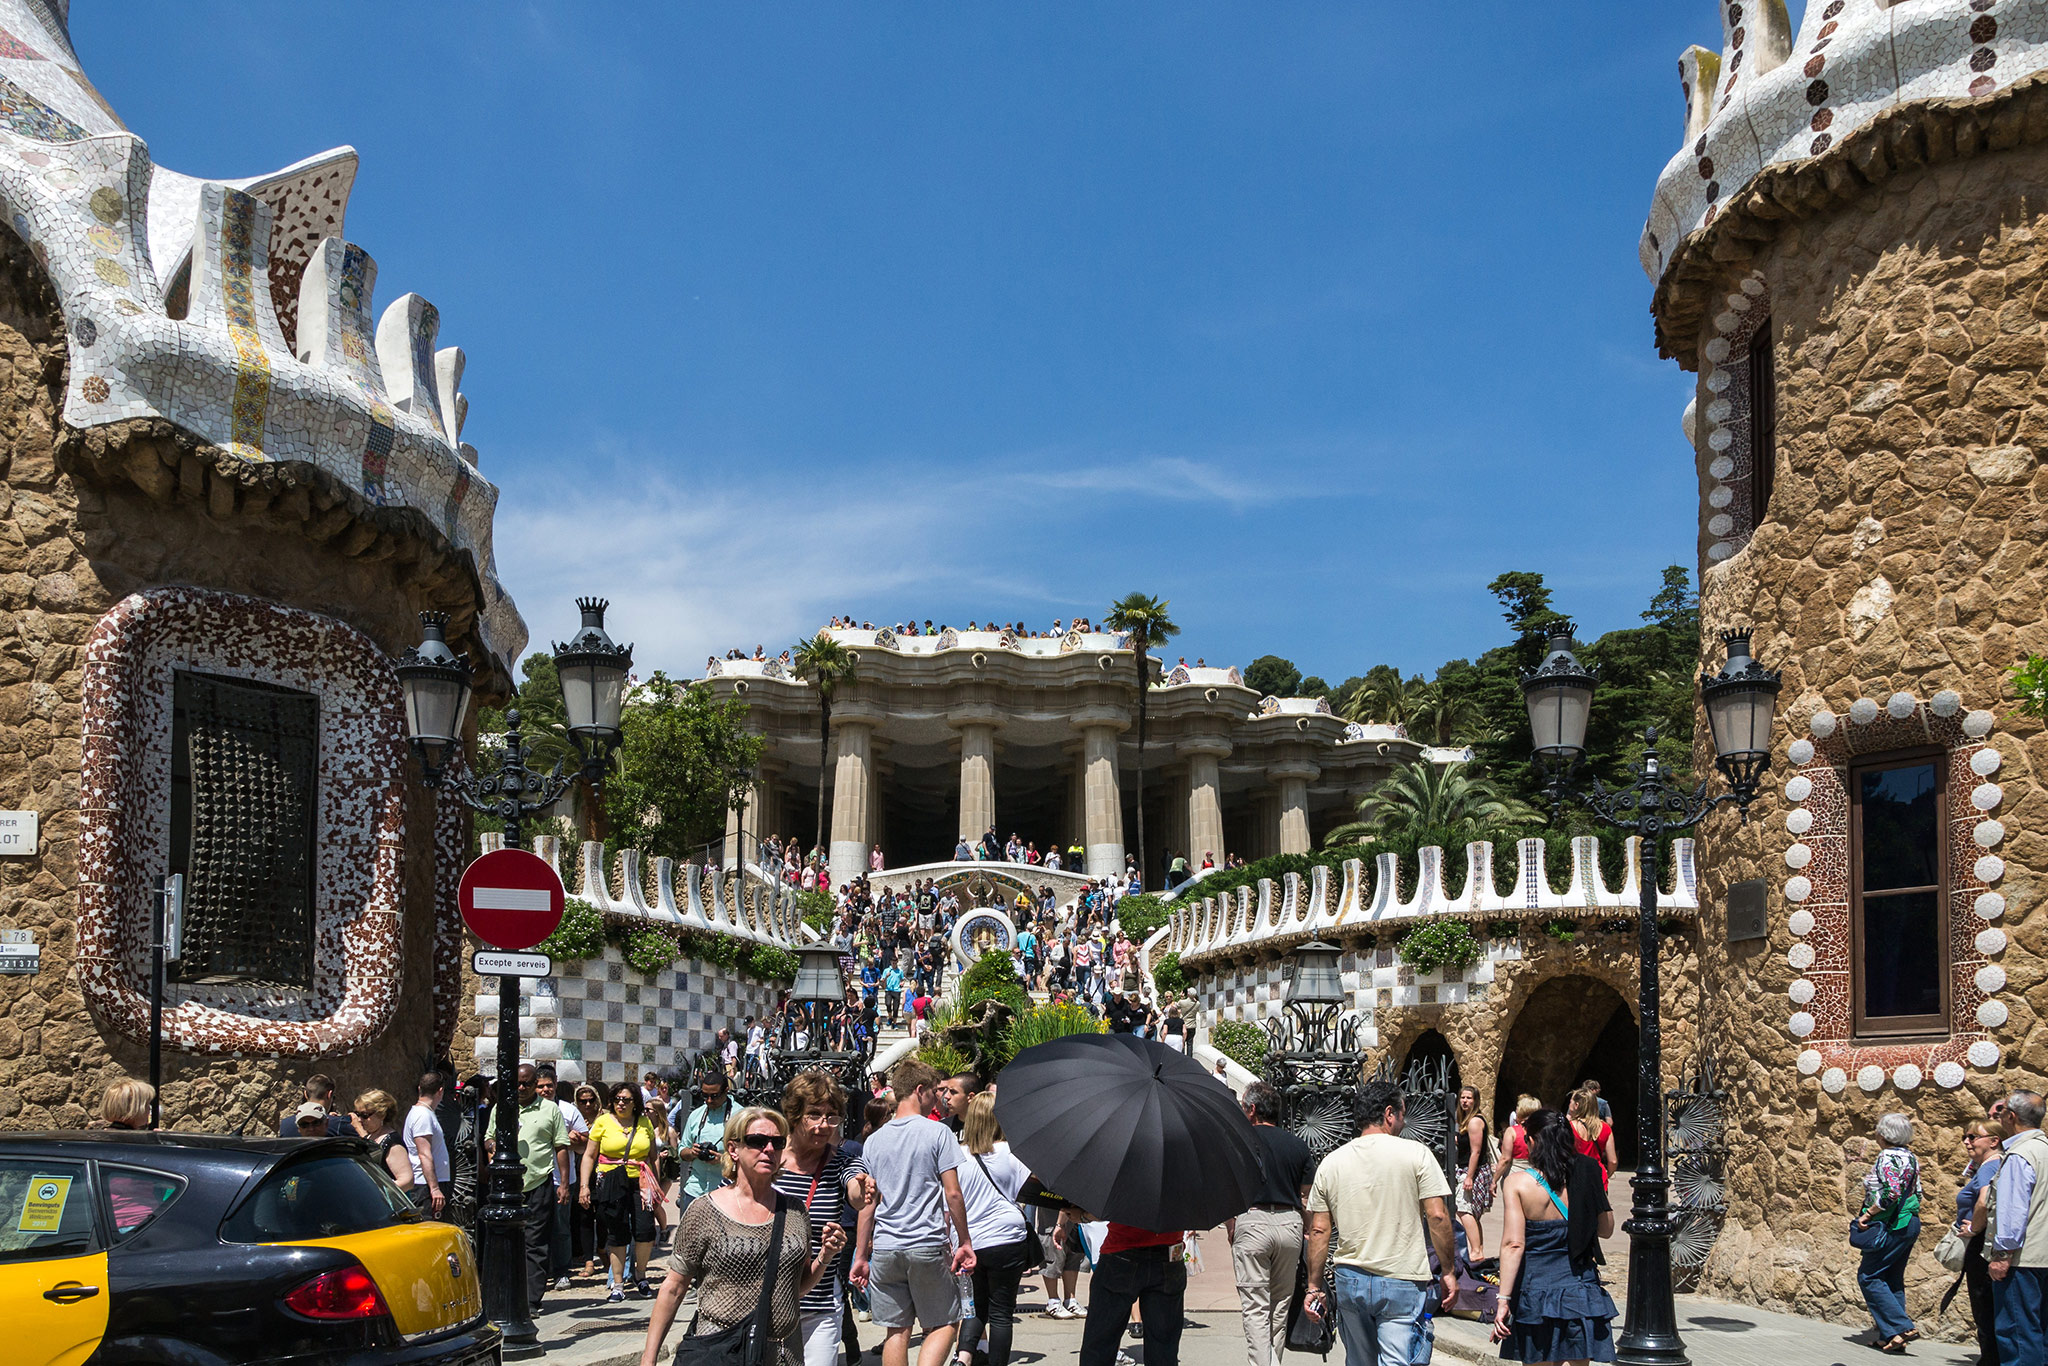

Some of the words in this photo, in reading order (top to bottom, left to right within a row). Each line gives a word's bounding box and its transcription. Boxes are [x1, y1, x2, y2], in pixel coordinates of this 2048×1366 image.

[0, 834, 20, 844] OT
[14, 932, 26, 942] 78
[478, 957, 512, 968] Excepte
[517, 960, 546, 969] serveis
